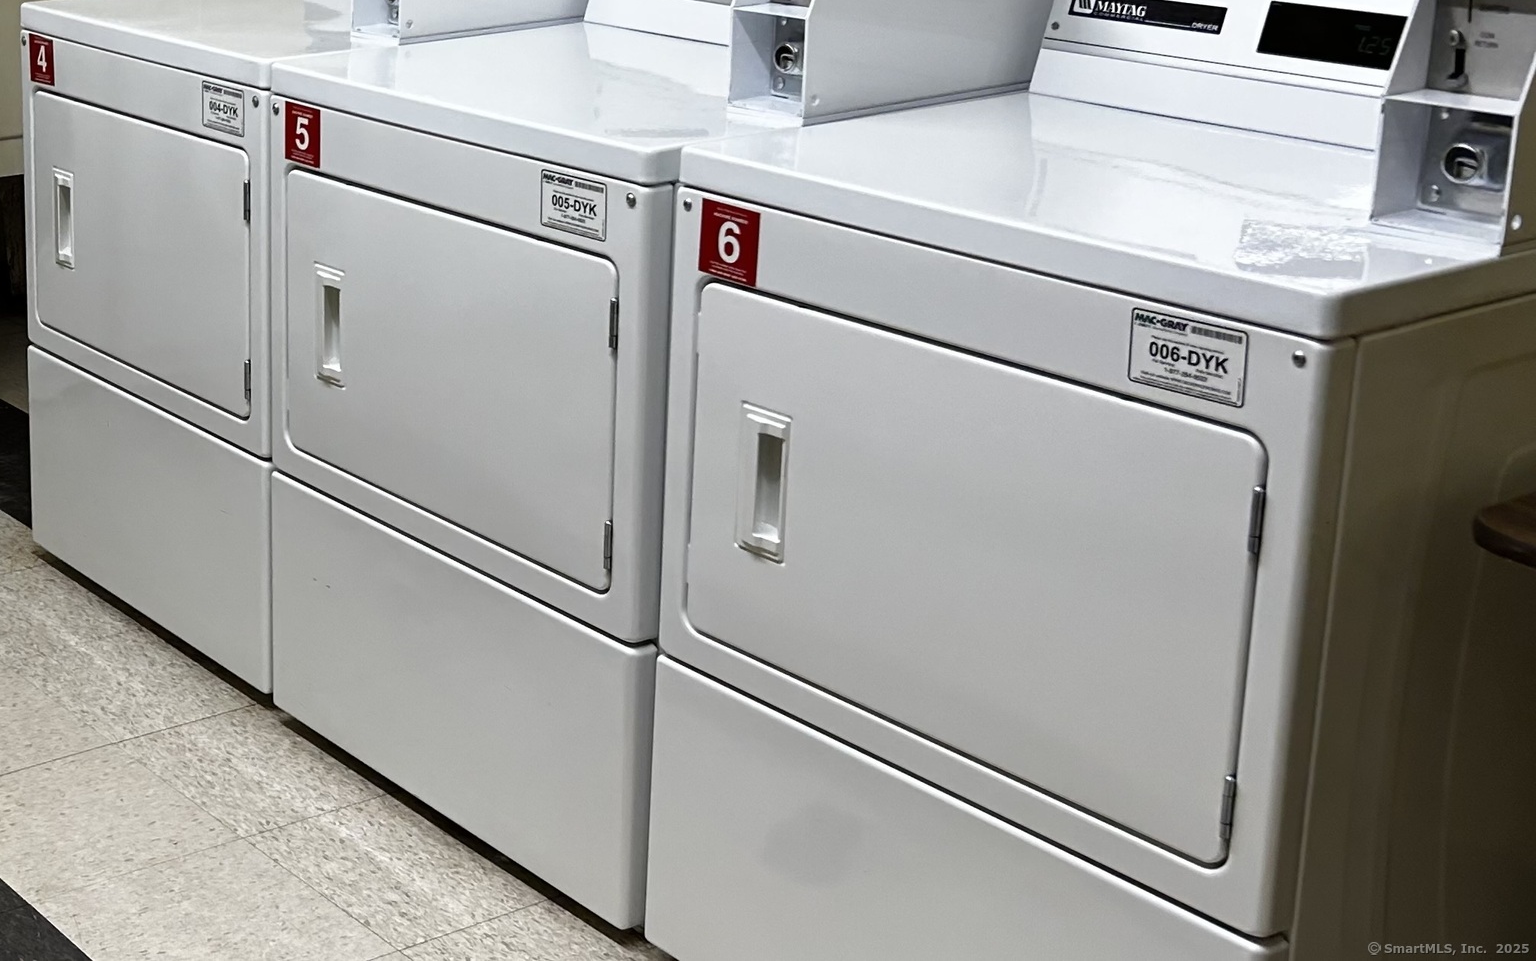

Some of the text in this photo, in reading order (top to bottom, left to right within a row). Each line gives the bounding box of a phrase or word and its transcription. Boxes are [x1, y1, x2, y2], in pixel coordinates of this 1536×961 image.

[1096, 0, 1148, 17] MAYTAG
[1191, 22, 1218, 31] DRYER
[37, 45, 47, 72] 4
[209, 101, 238, 117] 004-DYK
[295, 116, 309, 150] 5
[552, 194, 597, 217] 005-DYK
[718, 221, 741, 264] 6
[1149, 341, 1229, 374] 006-DYK
